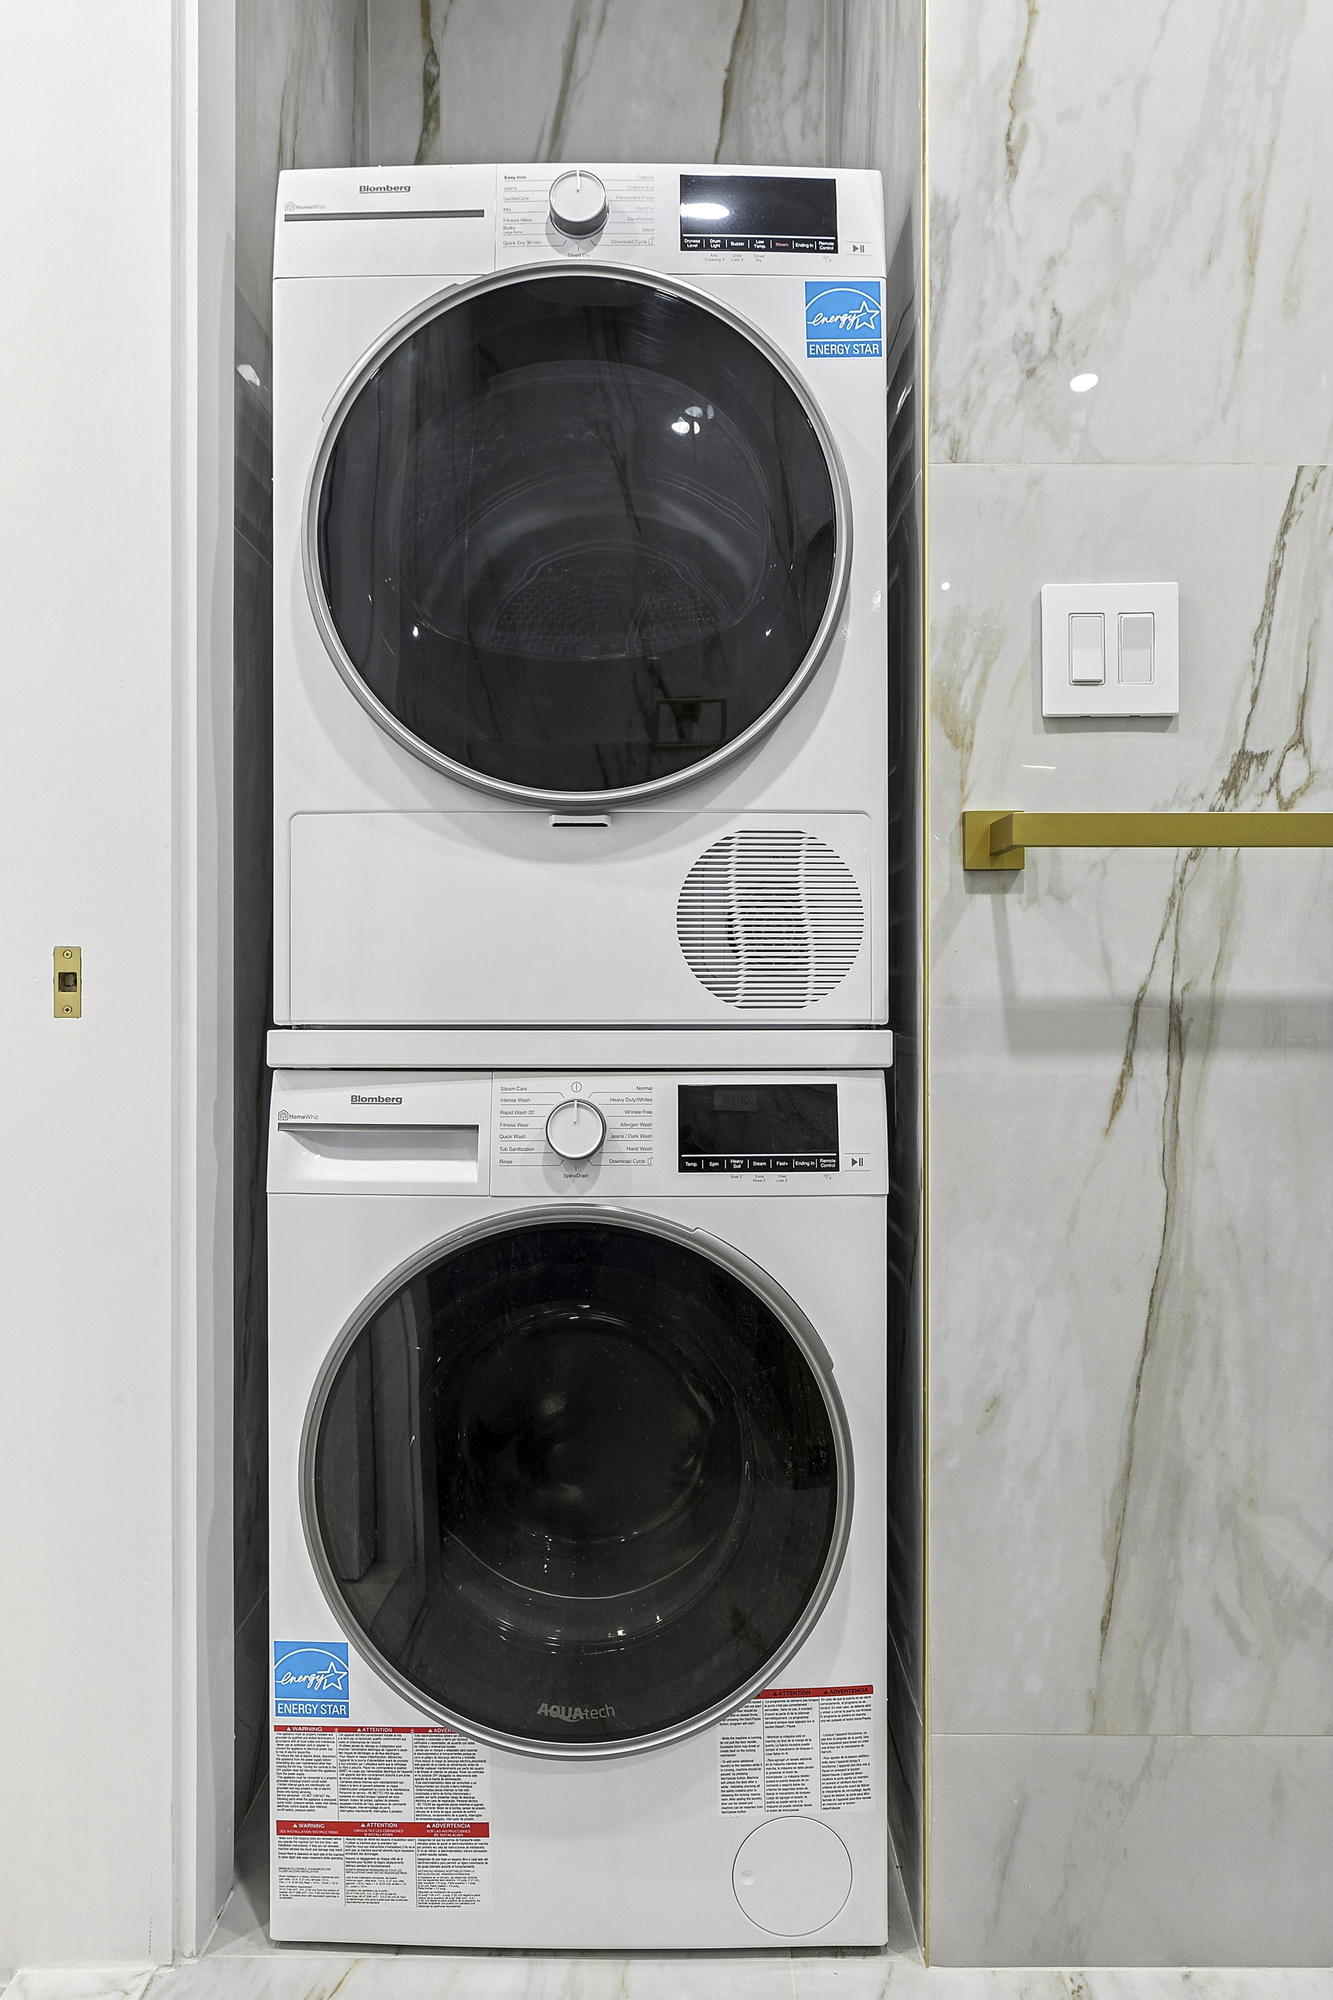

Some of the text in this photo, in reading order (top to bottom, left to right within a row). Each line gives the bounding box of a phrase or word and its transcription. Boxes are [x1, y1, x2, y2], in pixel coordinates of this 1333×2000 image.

[359, 185, 411, 194] Blomberg
[807, 312, 858, 331] energy
[809, 344, 879, 355] ENERGY STAR
[350, 1095, 403, 1104] Blomberg
[276, 1672, 325, 1691] energy
[278, 1703, 347, 1715] ENERGY STAR
[537, 1702, 616, 1722] AQUAtech
